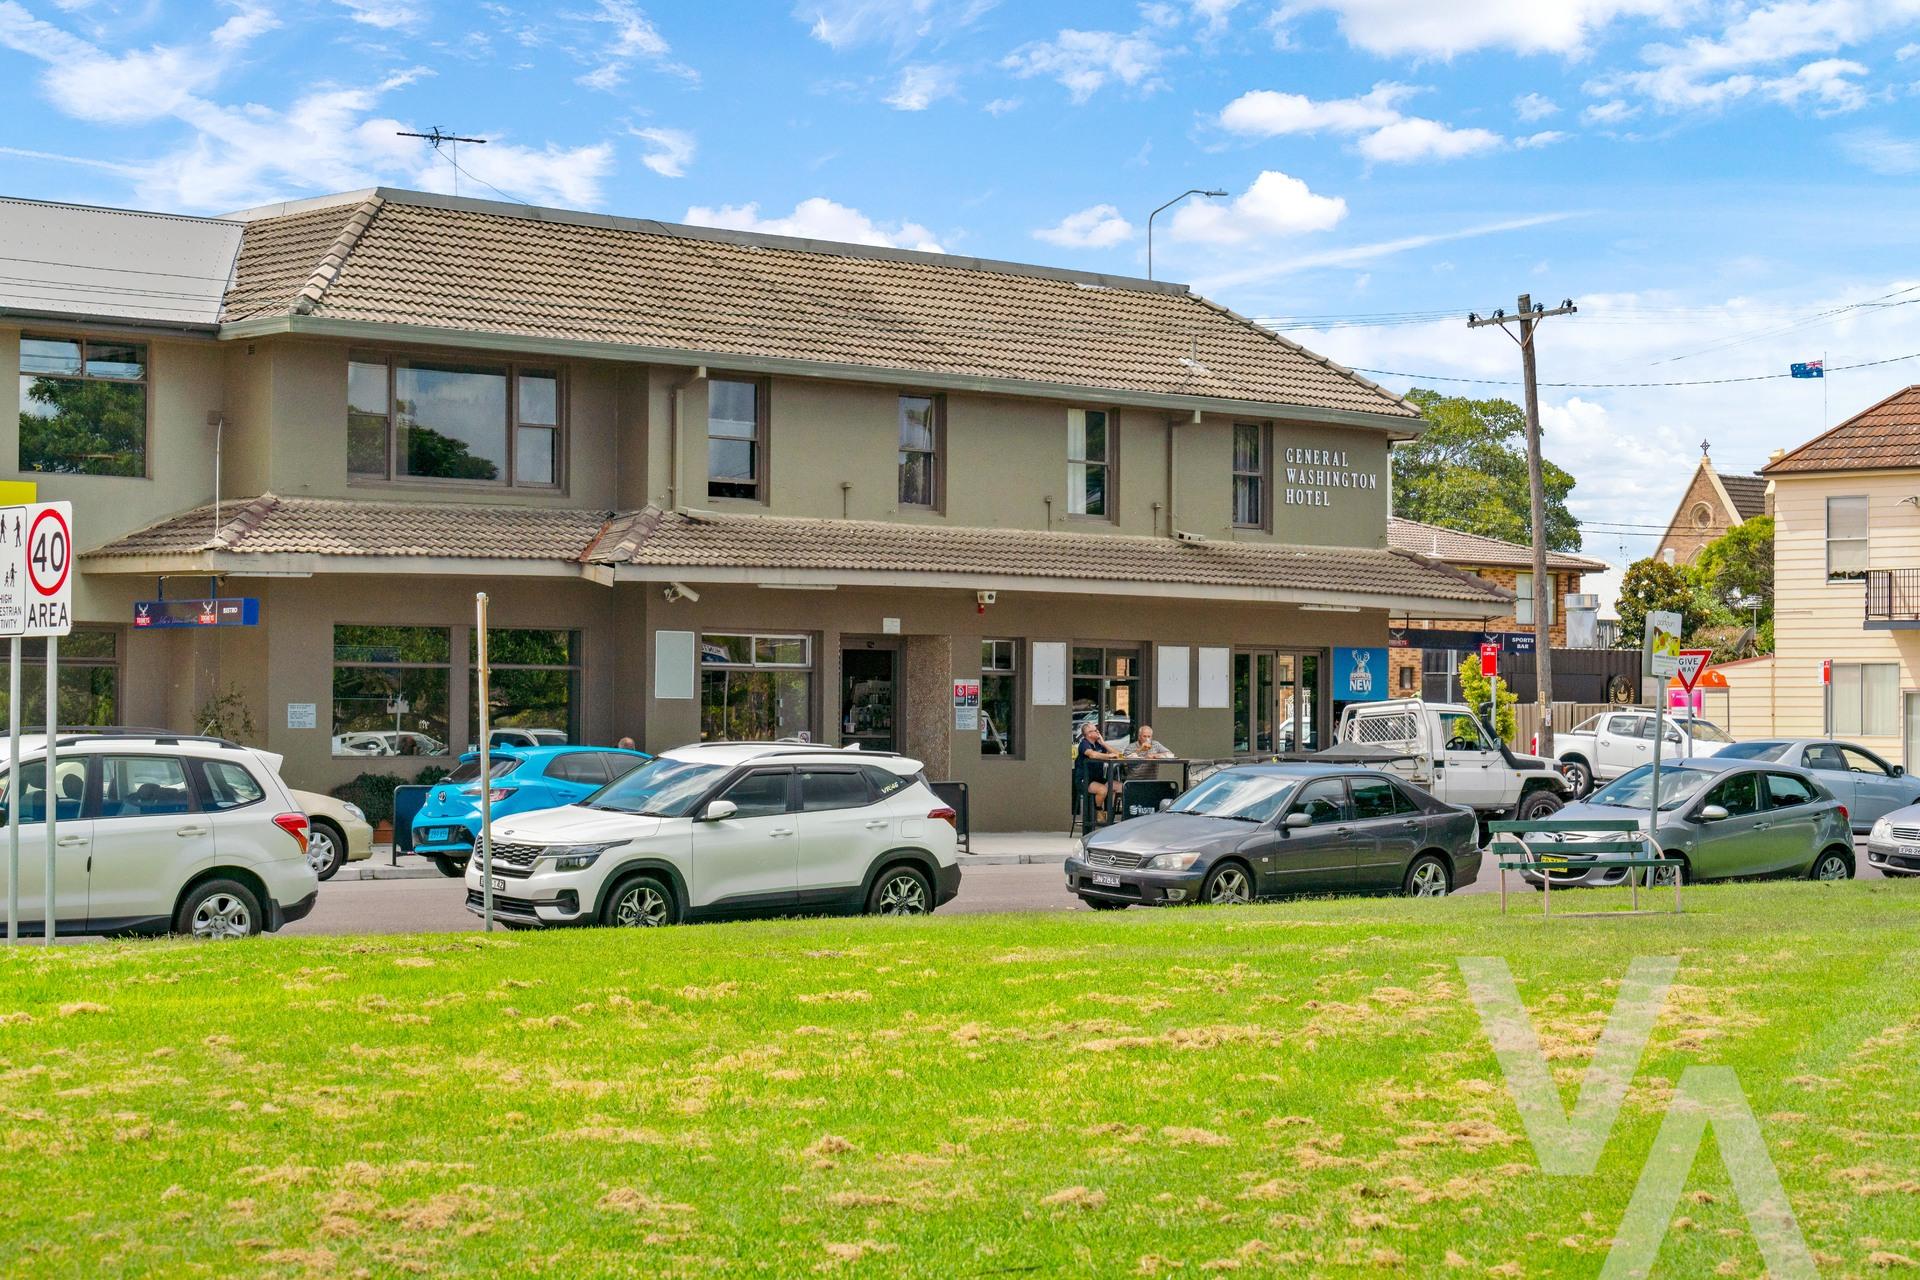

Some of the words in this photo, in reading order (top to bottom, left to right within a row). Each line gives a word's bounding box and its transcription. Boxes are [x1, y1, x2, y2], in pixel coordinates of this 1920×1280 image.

[1286, 448, 1348, 467] GENERAL
[1286, 468, 1377, 489] WASHINGTON
[1286, 488, 1330, 506] HOTEL
[33, 531, 65, 572] 40
[27, 602, 69, 628] AREA
[1350, 680, 1371, 691] NEW
